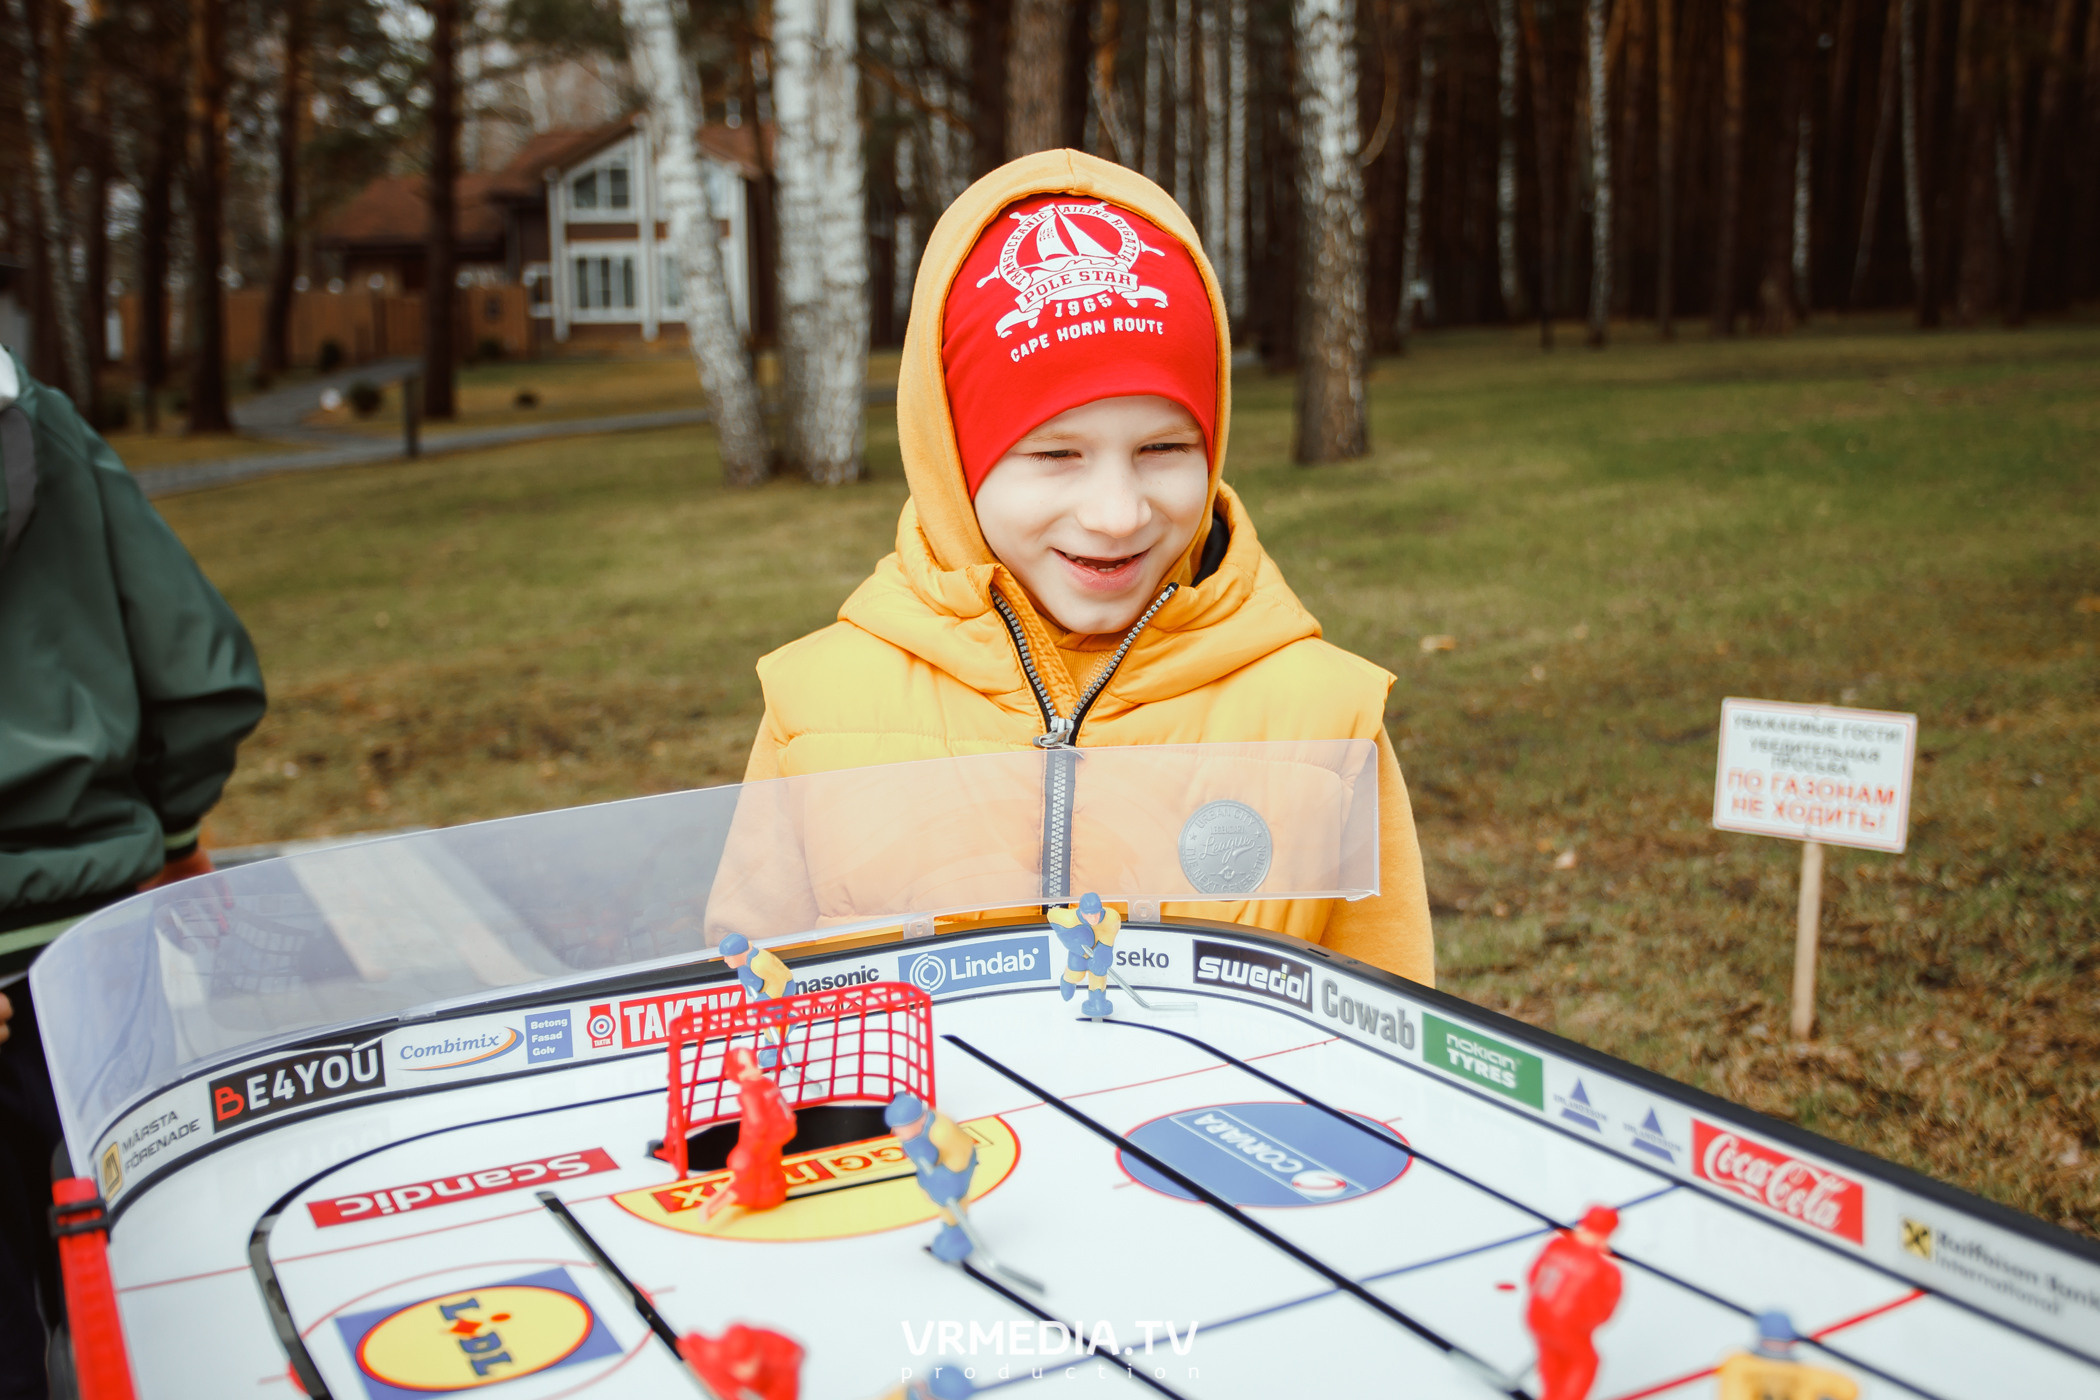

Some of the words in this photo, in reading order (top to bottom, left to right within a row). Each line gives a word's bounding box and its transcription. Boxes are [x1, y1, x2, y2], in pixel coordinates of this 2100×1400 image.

[1112, 219, 1137, 263] REGATTA
[1024, 274, 1073, 304] POLE
[1079, 270, 1132, 286] STAR
[1055, 293, 1112, 317] 1965
[1010, 333, 1050, 362] CAPE
[1056, 319, 1106, 342] HORN
[1113, 317, 1164, 335] ROUTE
[1727, 768, 1764, 794] ПО
[1771, 772, 1896, 806] ГАЗОНАМ
[1234, 807, 1256, 826] CITY
[1731, 795, 1764, 817] НЕ
[794, 965, 880, 996] nasonic
[950, 948, 1036, 980] Lindab
[1197, 956, 1310, 1003] swedol
[530, 1018, 568, 1030] Betong
[1321, 978, 1415, 1050] Cowab
[400, 1034, 499, 1060] Combimix
[531, 1030, 563, 1043] Fasad
[532, 1046, 556, 1056] Golv
[1446, 1032, 1517, 1072] nokian
[1446, 1047, 1517, 1089] TYRES
[334, 1153, 591, 1216] Scandic
